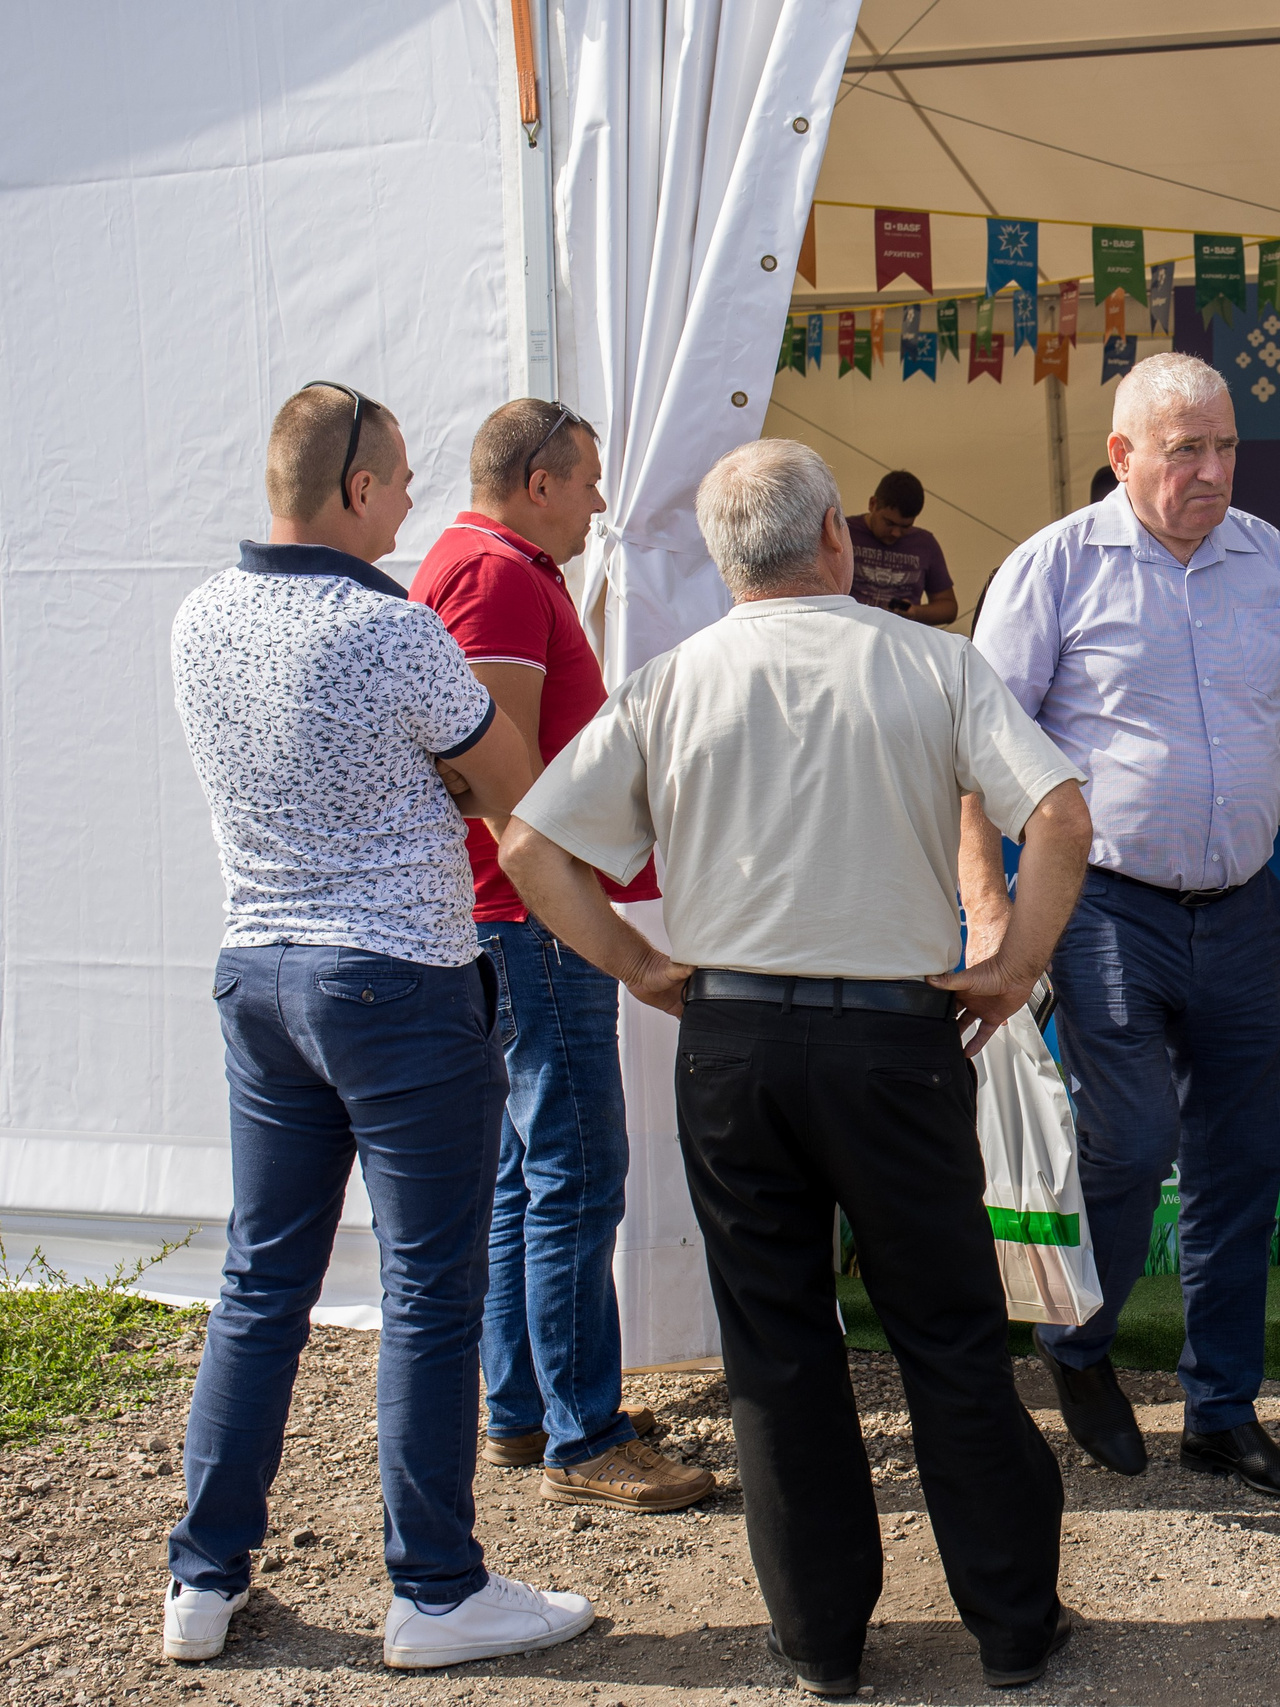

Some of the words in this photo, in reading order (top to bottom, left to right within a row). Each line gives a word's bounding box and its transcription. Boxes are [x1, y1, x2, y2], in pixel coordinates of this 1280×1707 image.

[897, 223, 921, 233] BASF
[1113, 239, 1136, 248] BASF
[1162, 1194, 1181, 1205] We
